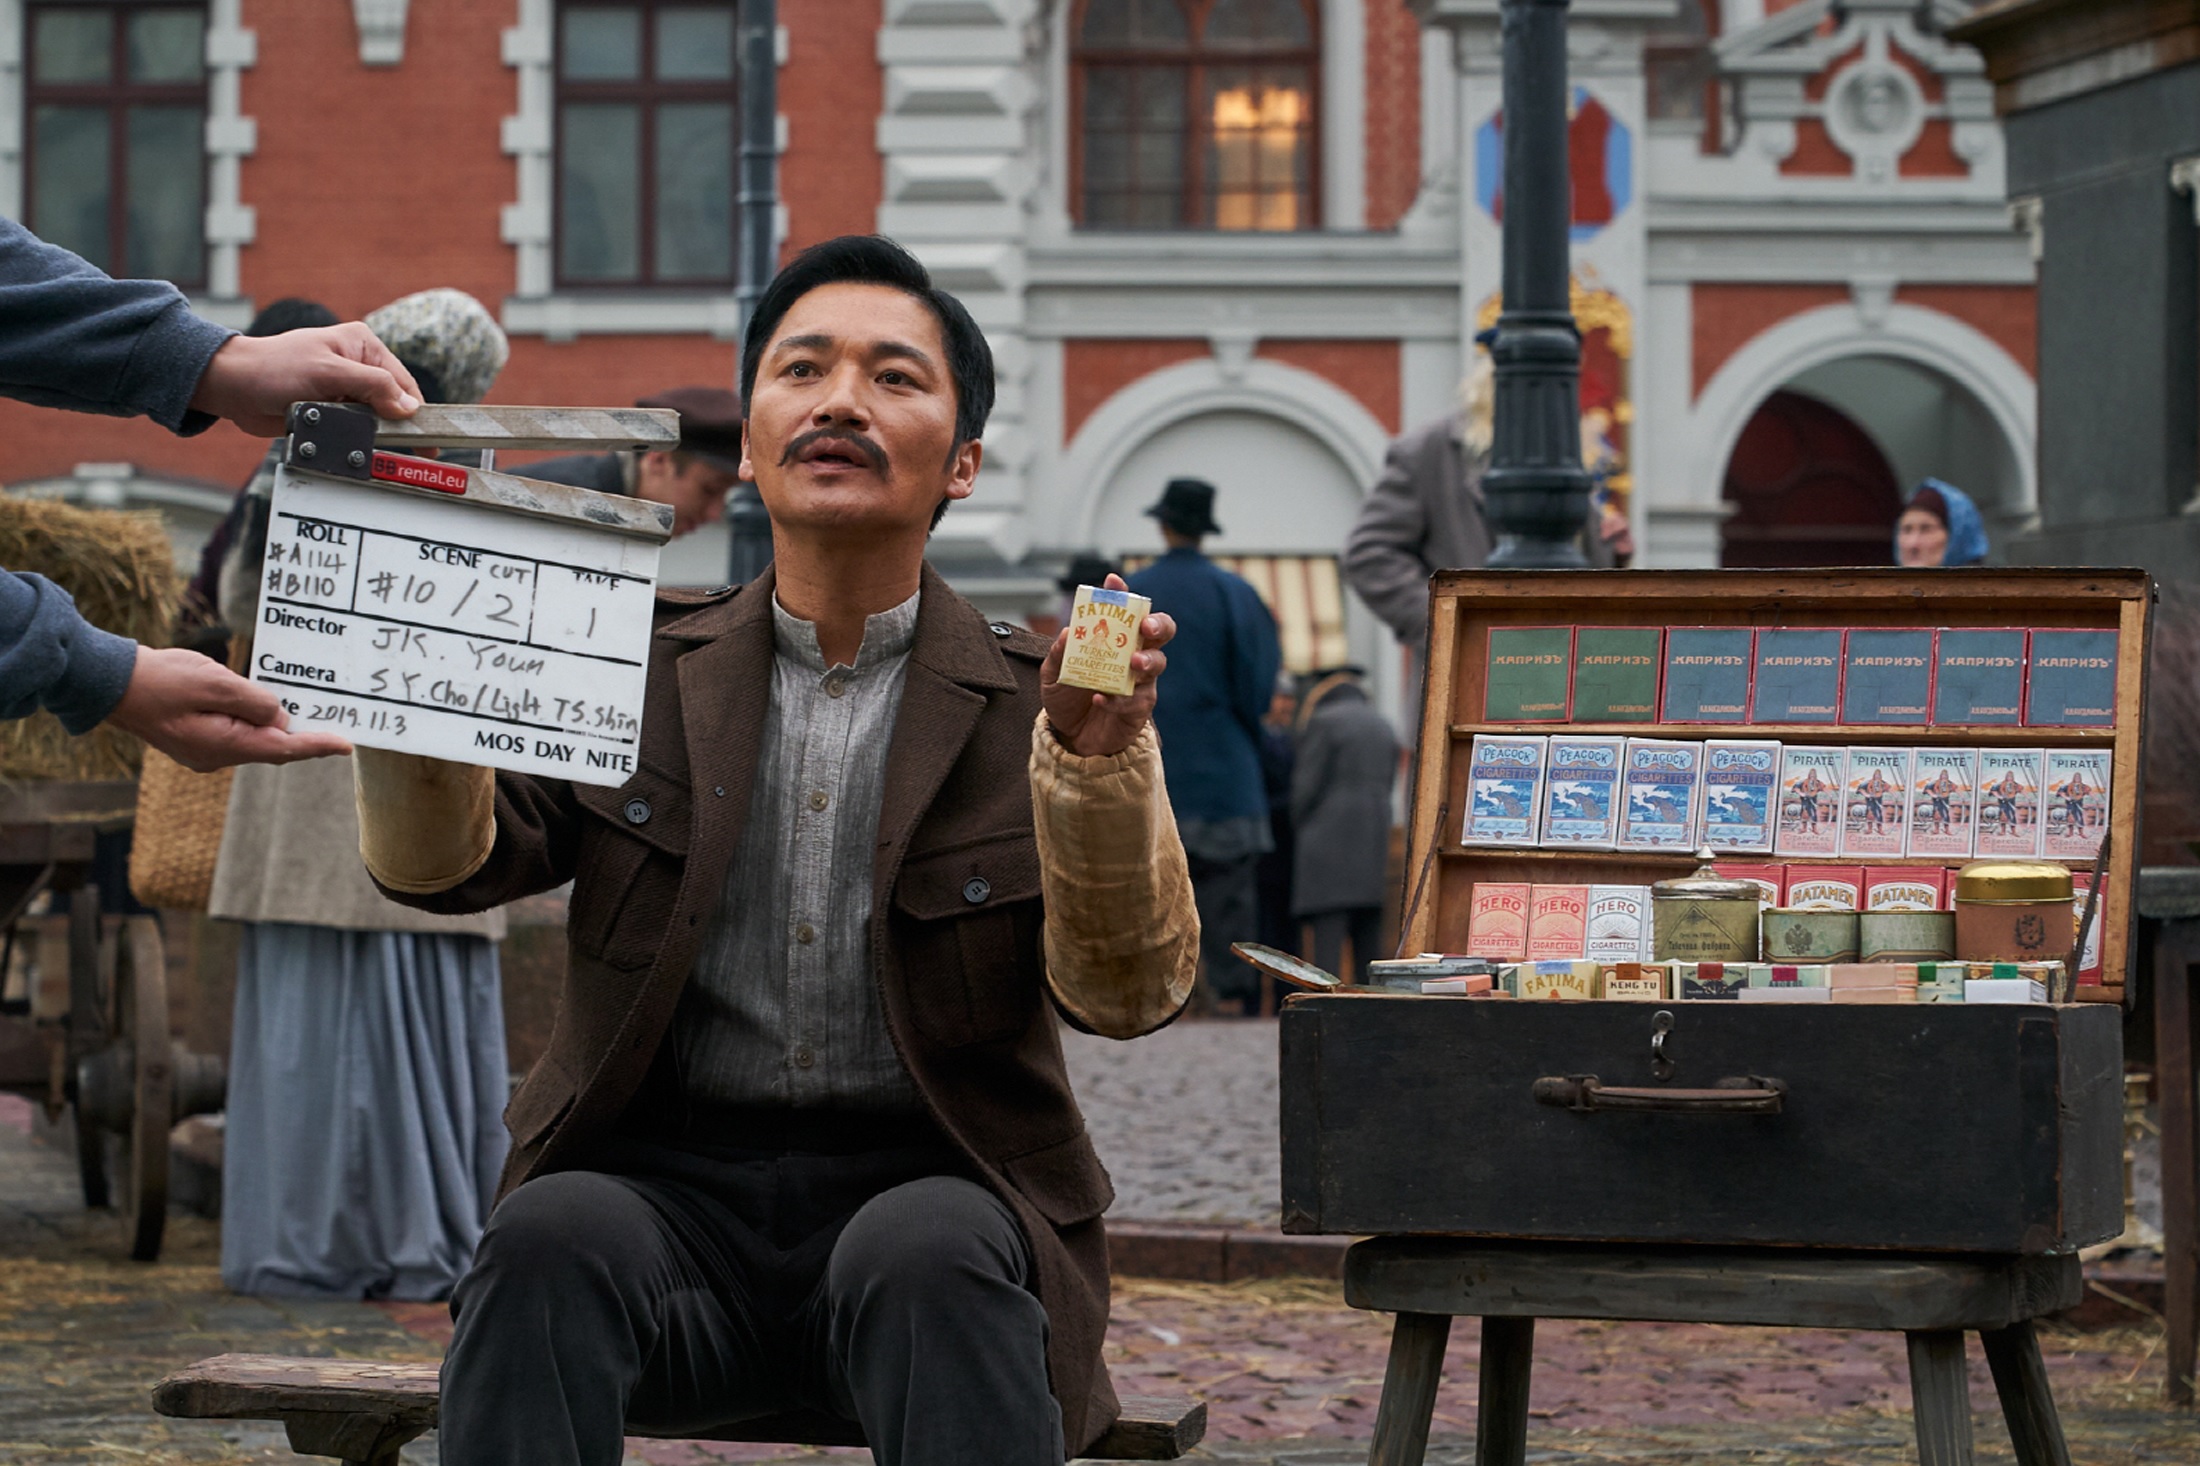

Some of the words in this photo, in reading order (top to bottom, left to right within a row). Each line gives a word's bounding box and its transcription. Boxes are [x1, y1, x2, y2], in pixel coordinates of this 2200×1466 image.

[296, 520, 347, 546] ROLL
[418, 543, 483, 569] SCENE
[489, 564, 531, 584] CUT
[486, 594, 520, 627] 2
[1076, 602, 1136, 628] FATIMA
[264, 607, 347, 637] Director
[587, 608, 595, 639] 1
[1079, 645, 1119, 659] TURKISH
[259, 653, 336, 683] Camera
[1067, 656, 1126, 674] CIGARETTES
[474, 730, 525, 754] MOS
[535, 740, 576, 763] DAY
[586, 749, 635, 774] NITE
[1475, 767, 1537, 780] CIGARETTES
[1552, 769, 1614, 781] CIGARETTES
[1630, 772, 1692, 784] CIGARETTES
[1709, 773, 1771, 785] CIGARETTES
[1479, 897, 1521, 912] HERO
[1538, 900, 1580, 914] HERO
[1596, 900, 1637, 914] HERO
[1472, 939, 1520, 947] CIGARETTES
[1532, 942, 1579, 950] CIGARETTES
[1591, 942, 1636, 950] CIGARETTES
[1525, 974, 1585, 994] FATIMA
[1644, 981, 1657, 990] TU
